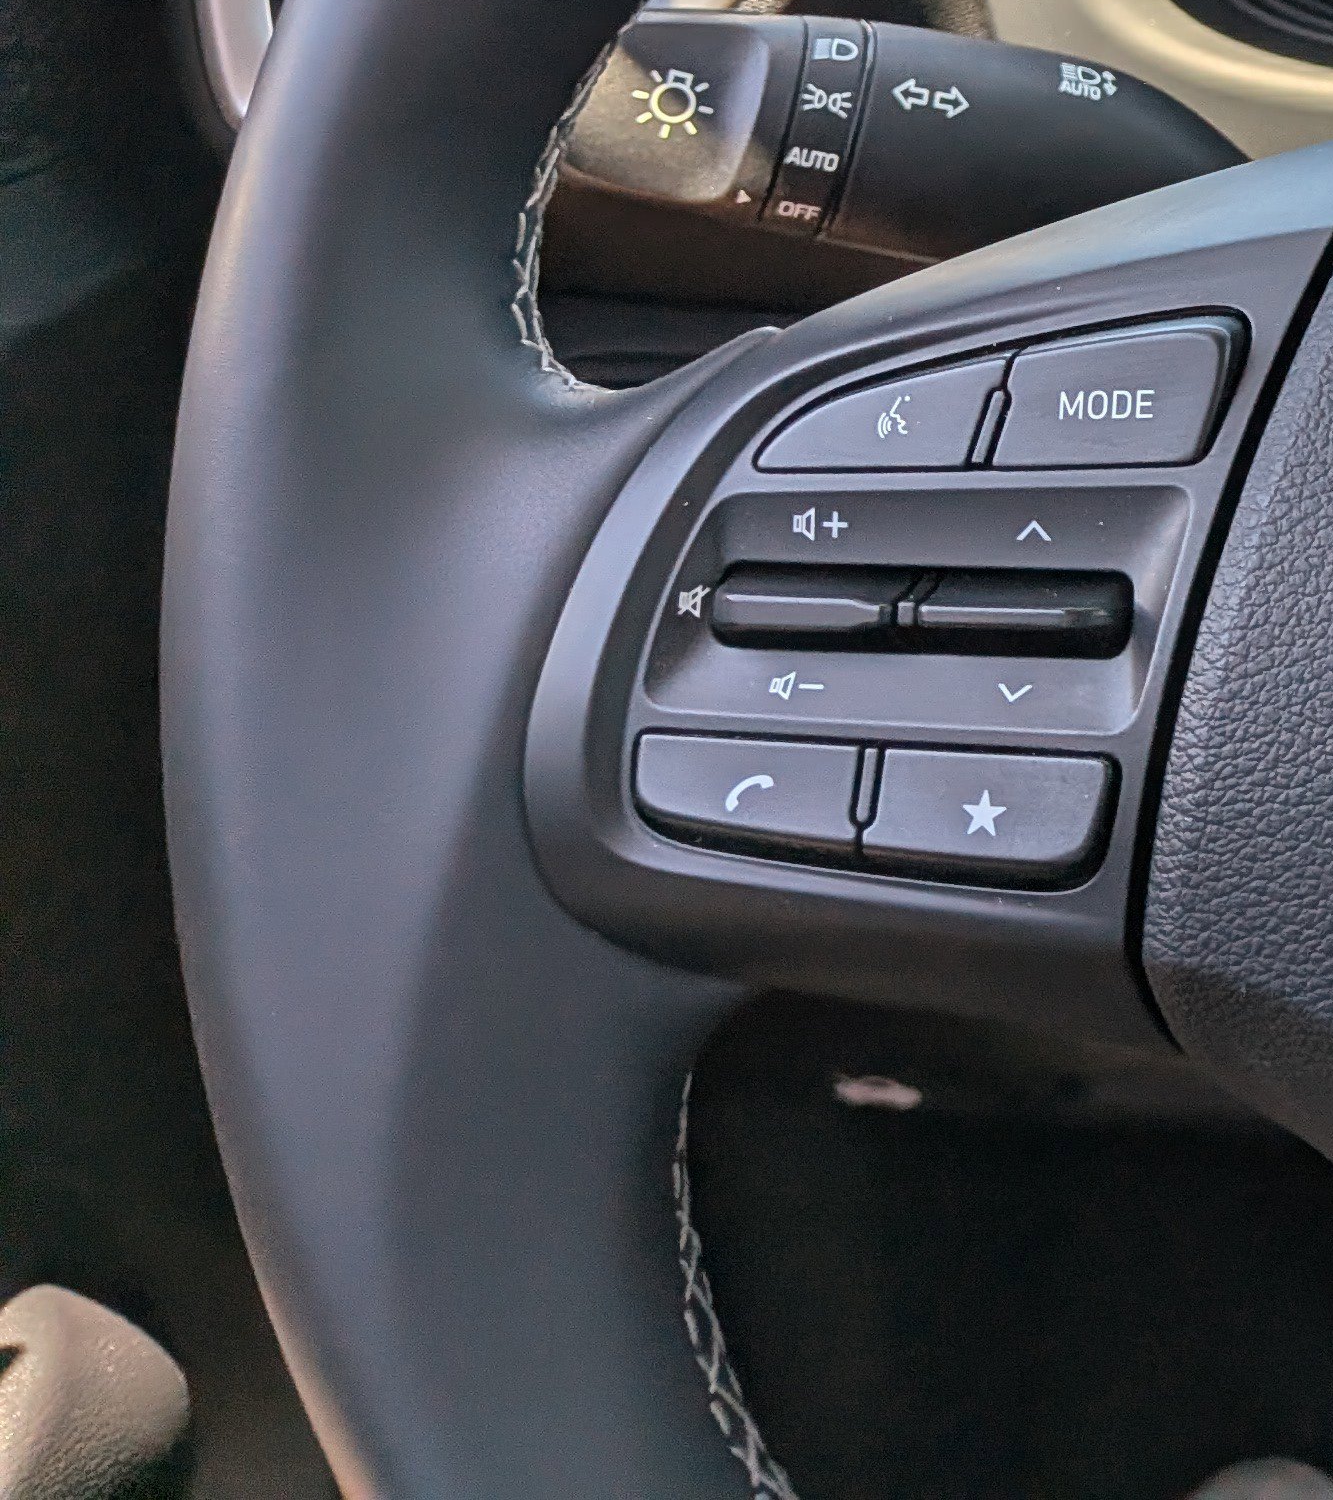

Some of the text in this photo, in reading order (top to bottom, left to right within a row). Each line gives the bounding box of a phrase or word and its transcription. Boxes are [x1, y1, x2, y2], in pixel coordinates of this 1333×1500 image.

[1061, 78, 1102, 101] AUTO
[785, 146, 839, 173] AUTO
[777, 200, 822, 221] OFF
[1058, 388, 1156, 420] MODE
